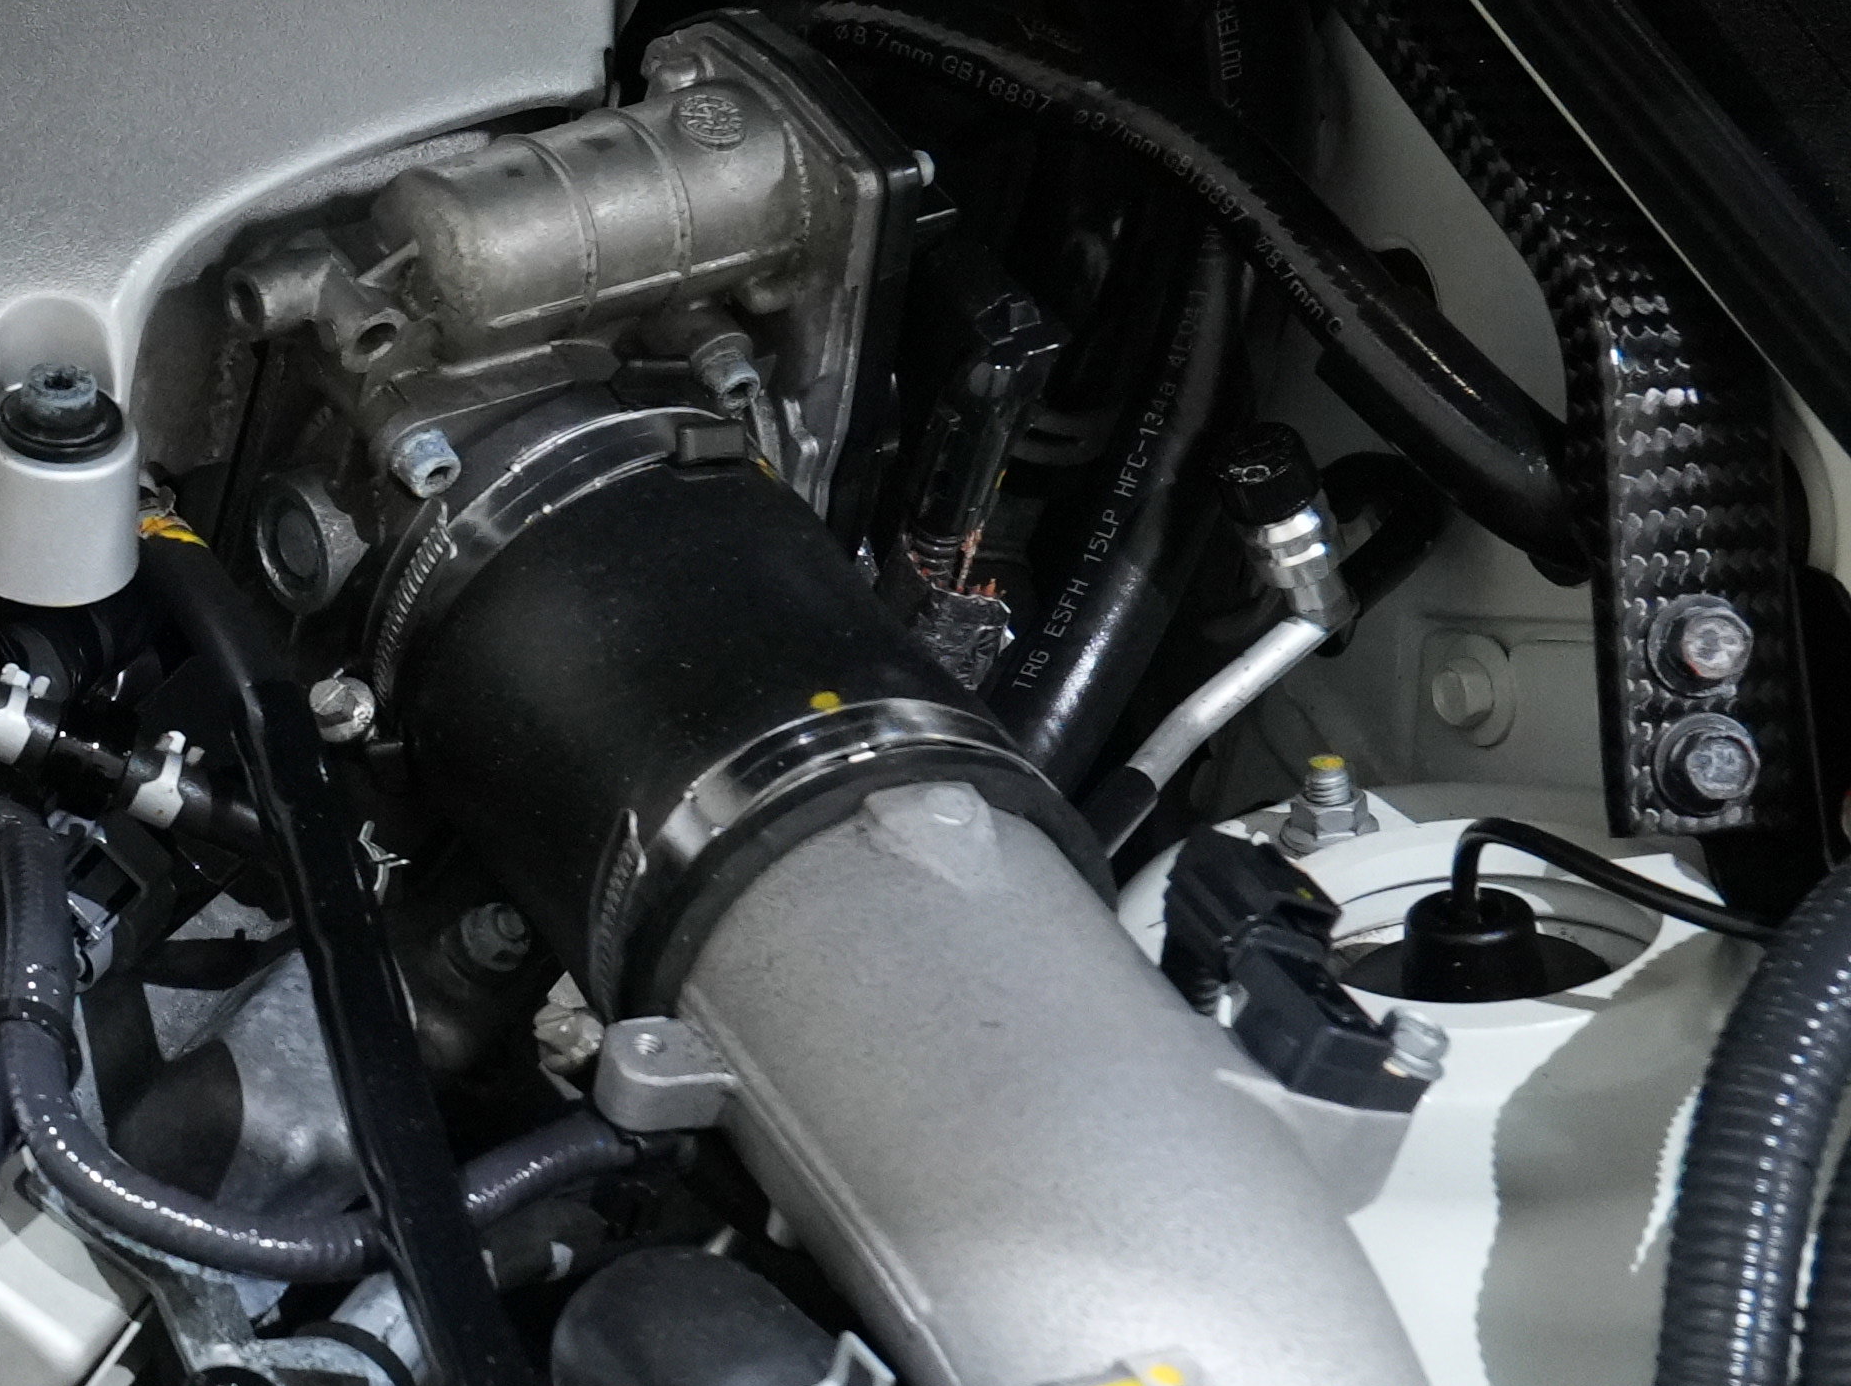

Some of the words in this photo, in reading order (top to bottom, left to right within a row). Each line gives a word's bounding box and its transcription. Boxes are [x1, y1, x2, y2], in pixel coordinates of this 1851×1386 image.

[1012, 648, 1050, 691] TRG
[1043, 577, 1089, 639] ESFH
[1083, 507, 1121, 564] 15LP
